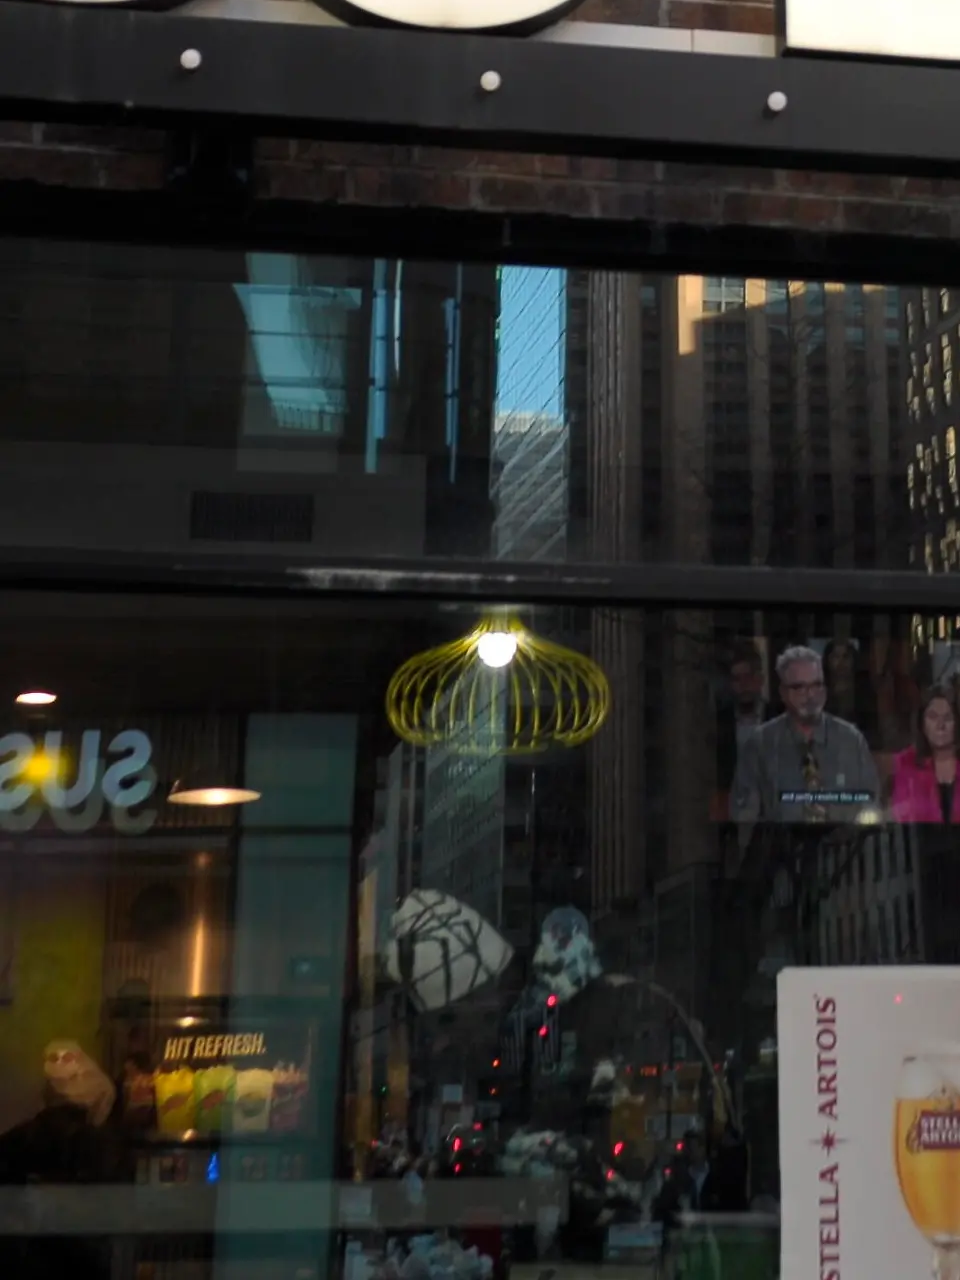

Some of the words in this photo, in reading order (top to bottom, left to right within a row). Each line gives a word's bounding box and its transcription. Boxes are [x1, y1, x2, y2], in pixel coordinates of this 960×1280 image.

[164, 1037, 193, 1061] HIT
[816, 996, 838, 1120] ARTOIS
[818, 1163, 840, 1280] STELLA
